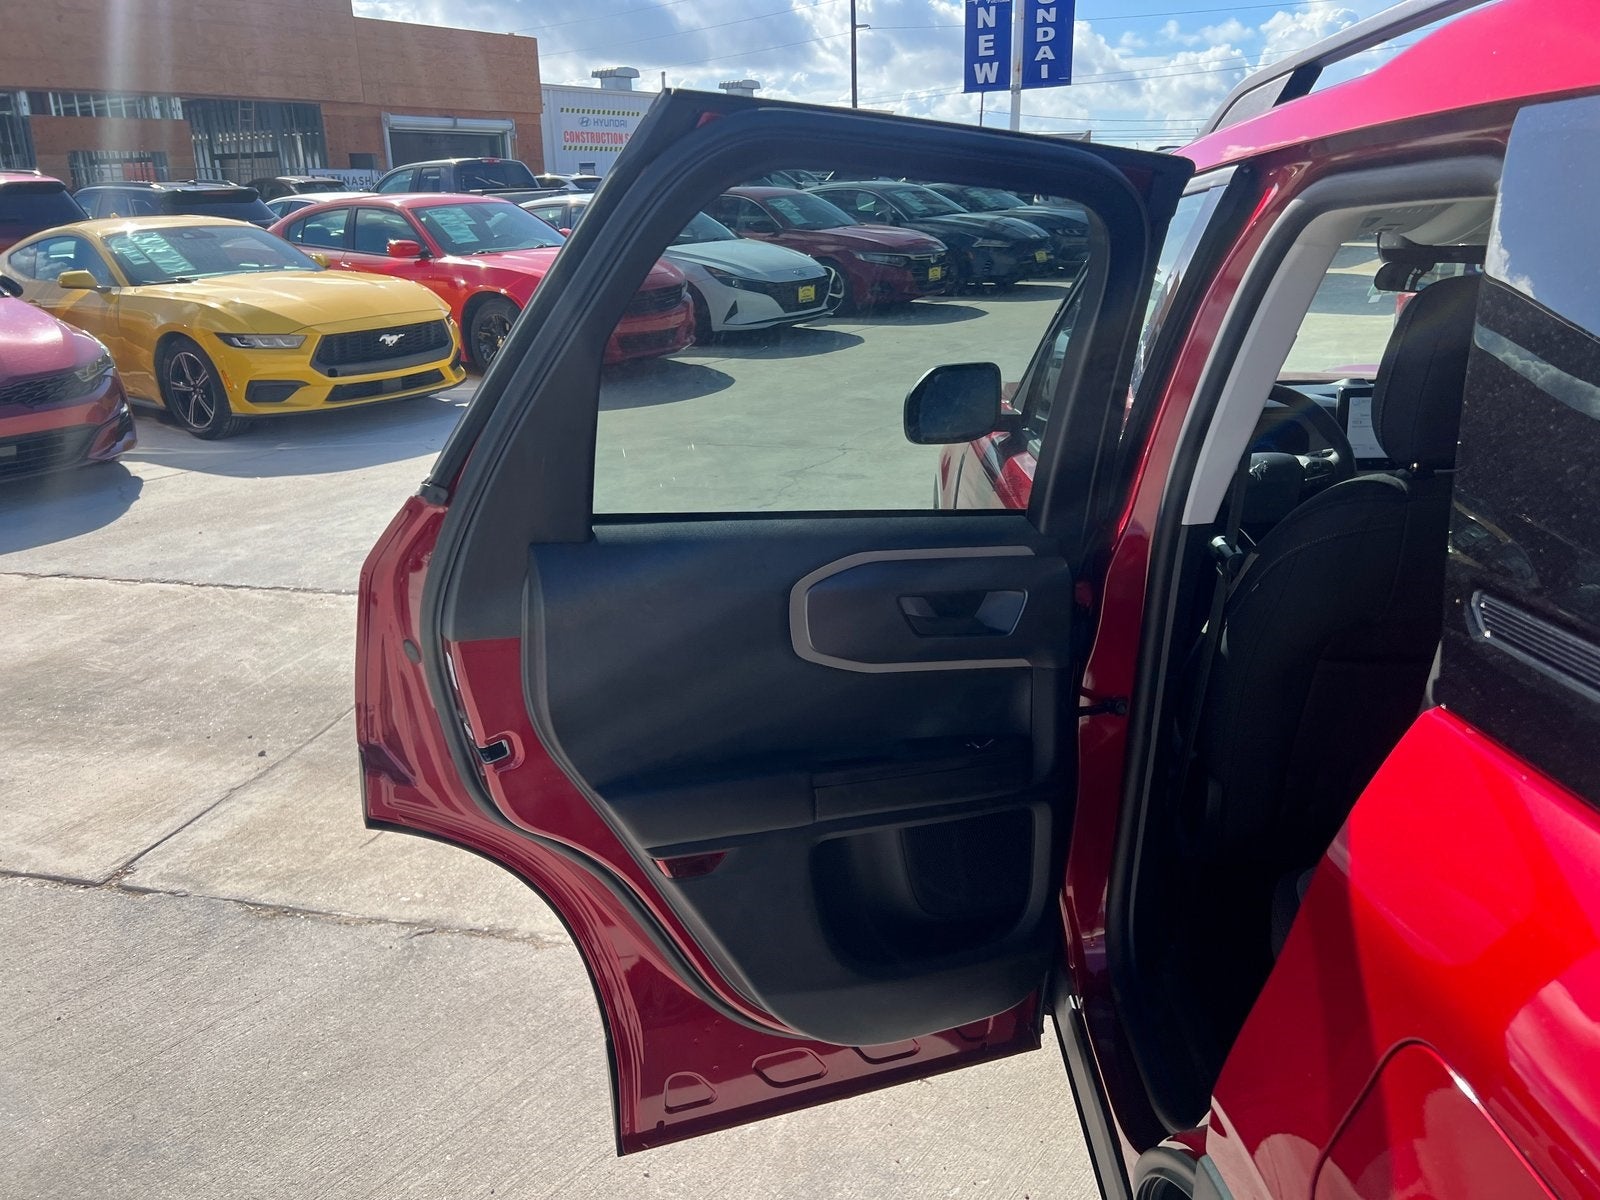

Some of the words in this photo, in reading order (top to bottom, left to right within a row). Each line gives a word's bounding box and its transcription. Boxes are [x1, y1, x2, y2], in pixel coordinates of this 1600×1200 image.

[974, 6, 999, 84] NEW
[1035, 0, 1056, 79] NDAI
[563, 130, 624, 145] CONSTRUCTION
[593, 118, 628, 128] HYUNDAI
